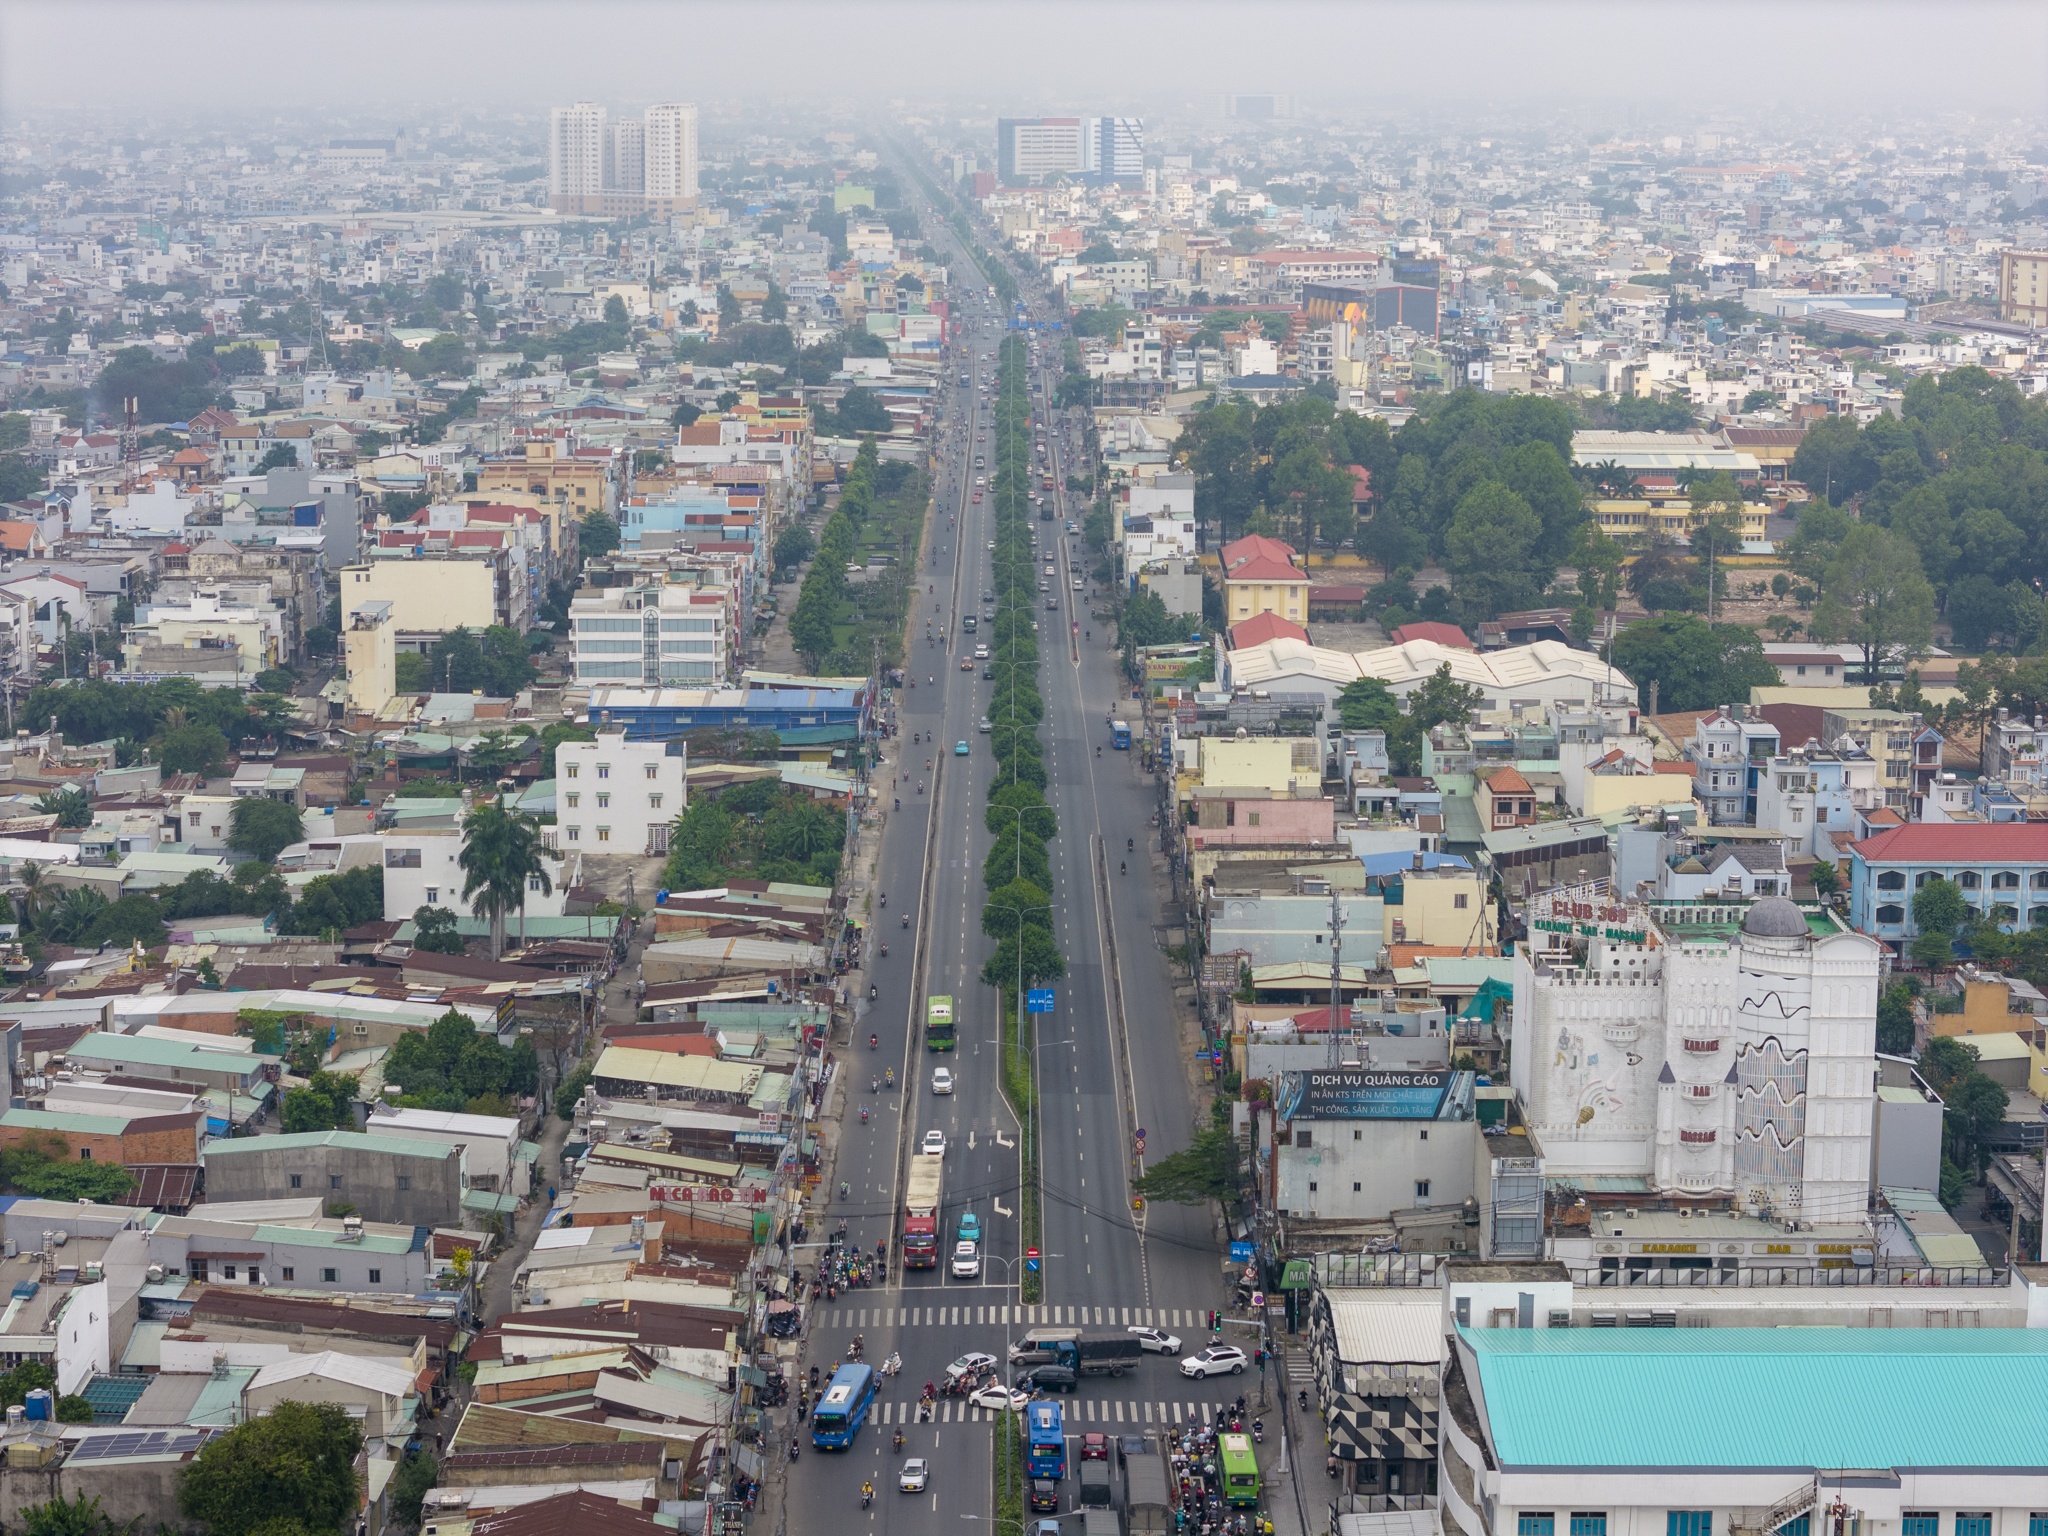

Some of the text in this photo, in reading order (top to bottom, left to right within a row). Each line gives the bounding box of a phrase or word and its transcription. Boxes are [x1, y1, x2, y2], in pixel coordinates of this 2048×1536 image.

[1552, 901, 1628, 923] CLUB 368
[1534, 920, 1573, 934] KARAOKE
[1581, 925, 1598, 936] BAR
[1605, 928, 1646, 942] MASSAGE
[1684, 1039, 1719, 1051] KARAOKE
[1311, 1072, 1439, 1087] DỊCH VỤ QUẢNG CÁO
[1311, 1091, 1320, 1099] IN
[1336, 1091, 1350, 1099] KTS
[1352, 1089, 1371, 1099] TRÊN
[1693, 1086, 1710, 1097] BAR
[1311, 1105, 1324, 1113] THI
[1326, 1103, 1351, 1115] CÔNG,
[1352, 1103, 1368, 1114] SẢN
[1392, 1104, 1409, 1115] QUÀ
[1411, 1104, 1432, 1115] TẶNG
[1680, 1130, 1716, 1143] MASSAGE
[649, 1186, 693, 1201] MICA
[1642, 1244, 1697, 1254] KARAOKE
[1767, 1244, 1791, 1254] BAR
